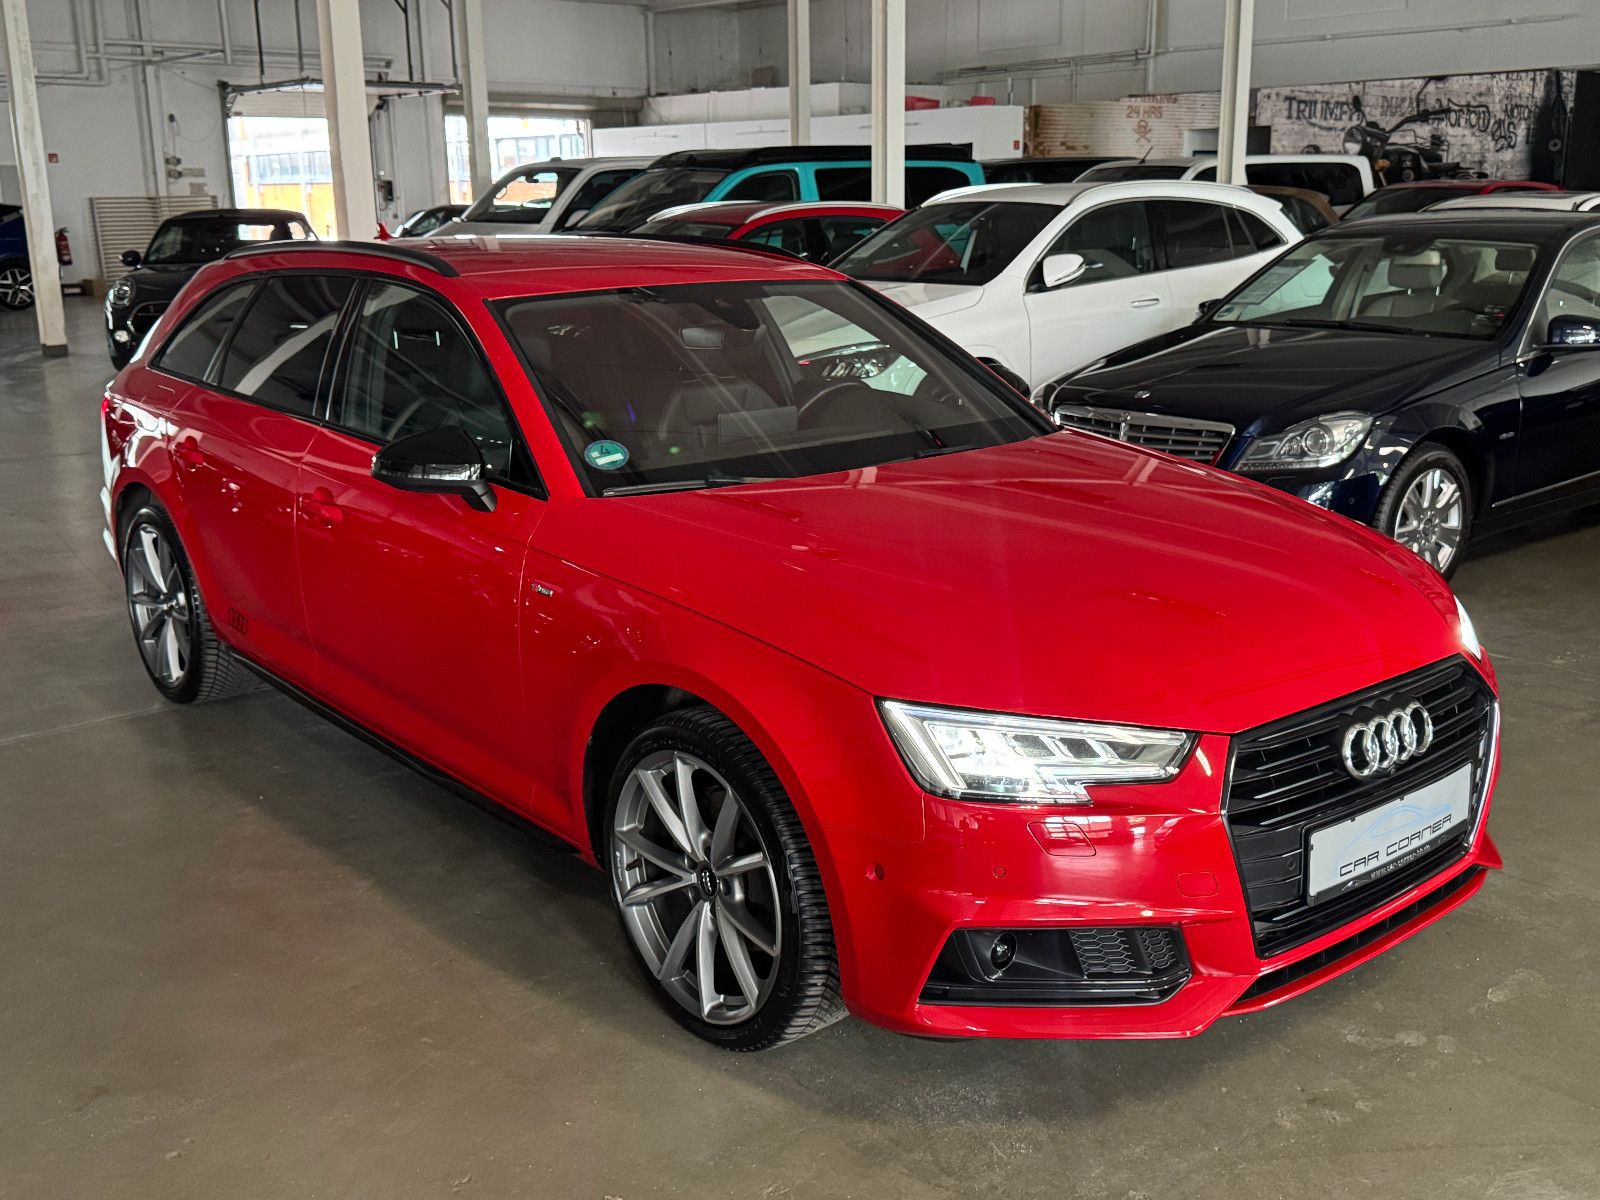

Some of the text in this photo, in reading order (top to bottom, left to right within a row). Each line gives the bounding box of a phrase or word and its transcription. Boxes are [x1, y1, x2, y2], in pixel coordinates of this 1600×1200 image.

[1126, 105, 1140, 119] 24
[1339, 813, 1452, 877] CAR CORNER
